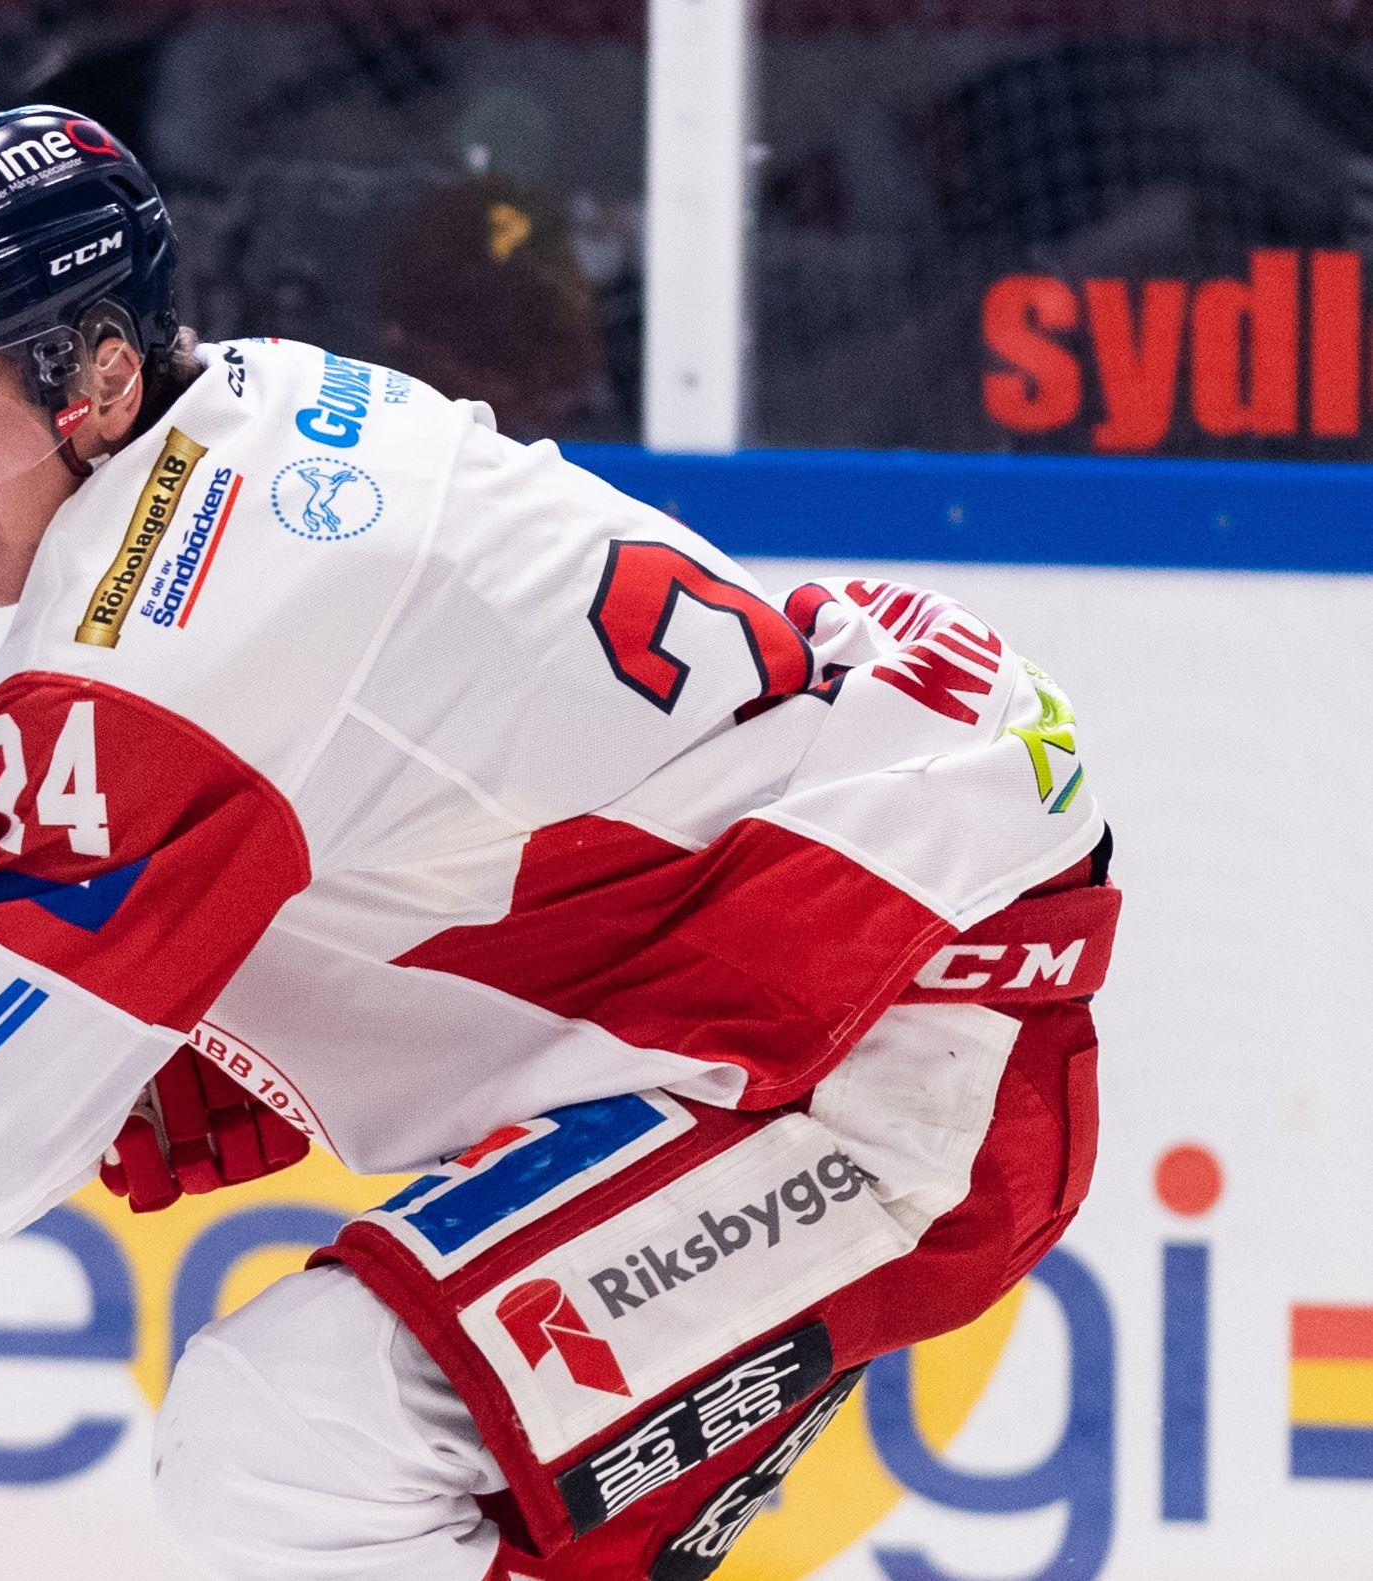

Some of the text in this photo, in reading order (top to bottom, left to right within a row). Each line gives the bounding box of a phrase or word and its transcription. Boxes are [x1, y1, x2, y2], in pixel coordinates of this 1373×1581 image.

[49, 231, 124, 276] CCM
[58, 404, 90, 428] CCM
[980, 248, 1373, 452] sydl
[92, 455, 187, 625] Rörbolaget AB
[140, 560, 173, 617] En del av
[152, 467, 233, 628] Sandbäckens
[588, 539, 853, 726] 2
[913, 938, 1086, 990] CM
[588, 1150, 880, 1319] Riksbygg
[693, 1340, 800, 1459] klea
